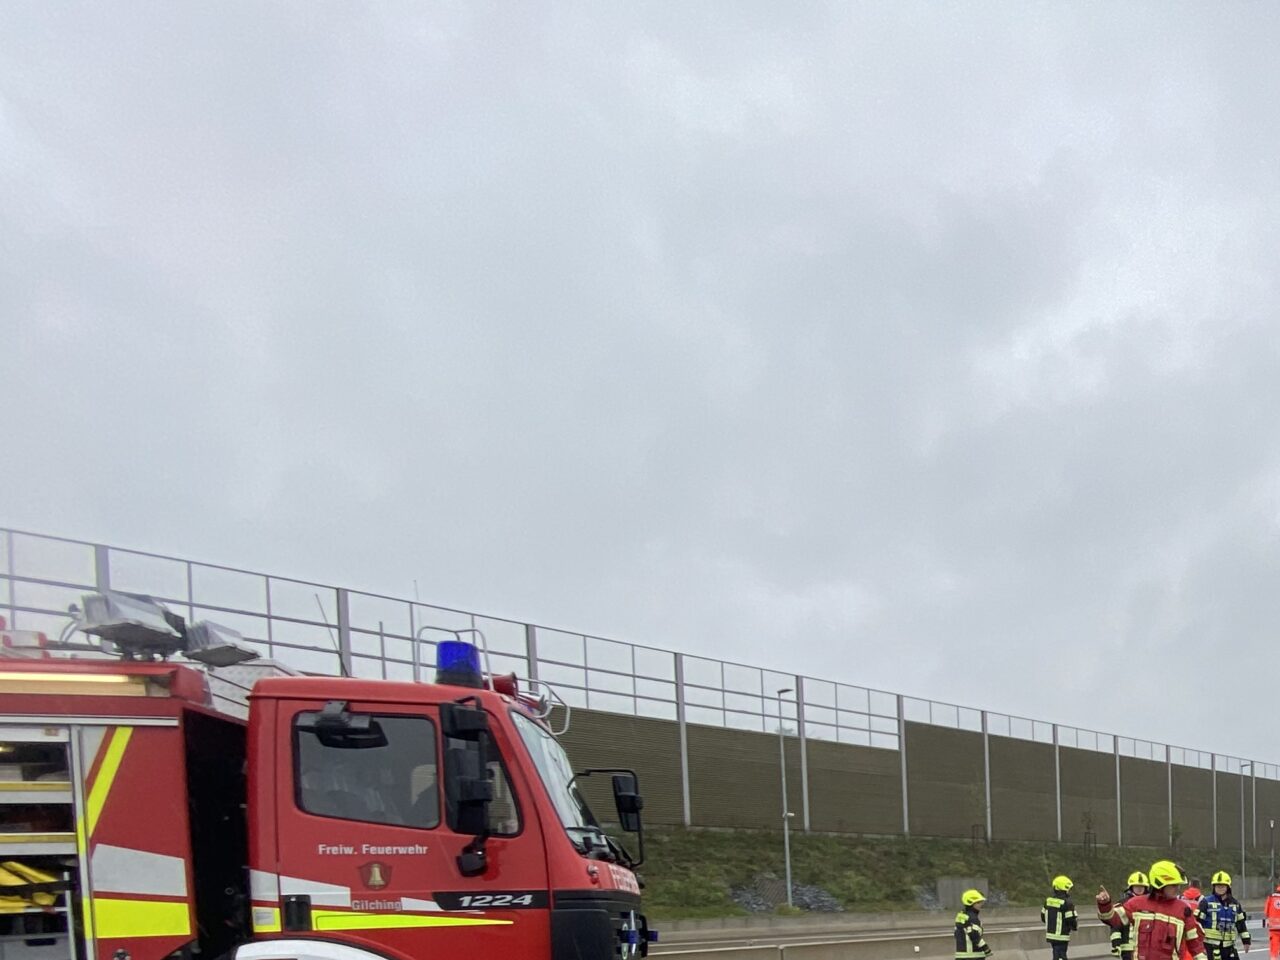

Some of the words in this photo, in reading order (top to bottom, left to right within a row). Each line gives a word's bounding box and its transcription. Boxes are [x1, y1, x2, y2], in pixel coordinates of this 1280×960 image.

[318, 844, 358, 855] Freiw.
[362, 844, 428, 855] Feuerwehr
[351, 900, 402, 911] Gilching
[458, 894, 533, 907] 1224
